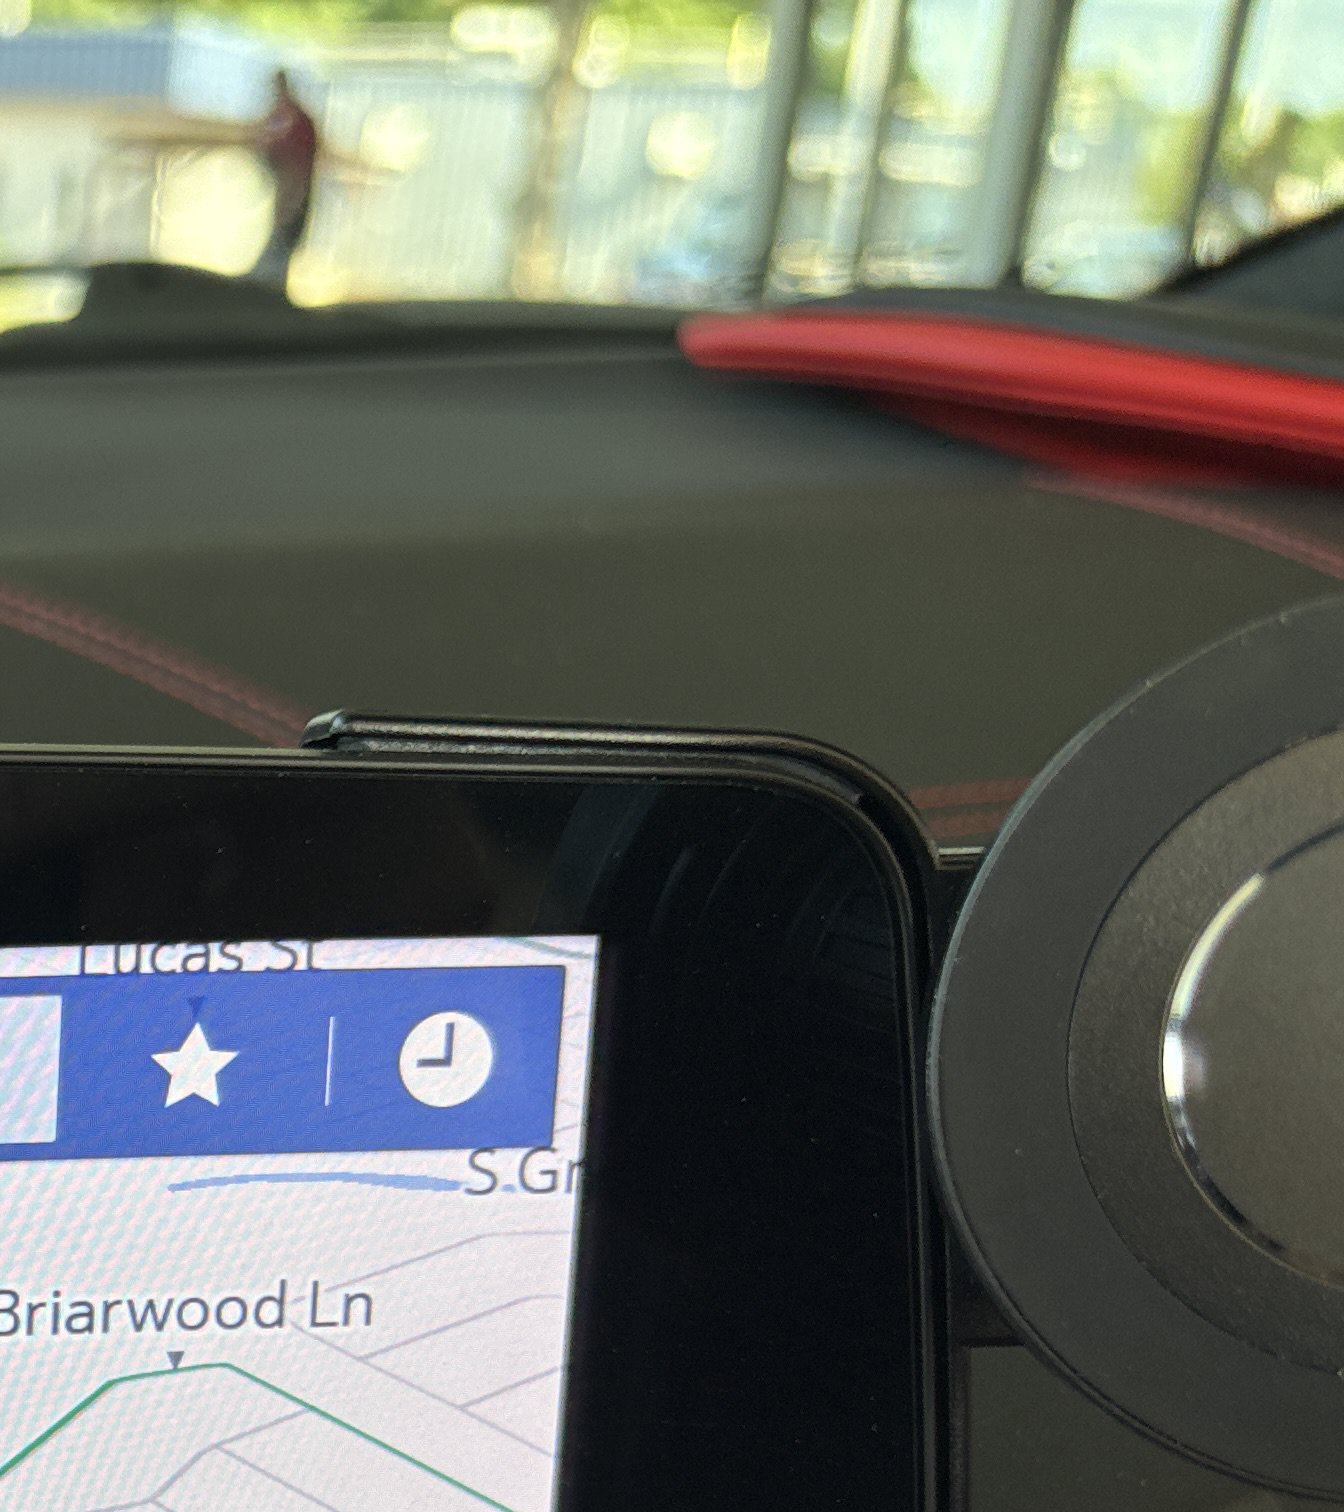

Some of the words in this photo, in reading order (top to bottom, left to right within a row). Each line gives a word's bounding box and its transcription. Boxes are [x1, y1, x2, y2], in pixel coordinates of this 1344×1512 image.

[79, 940, 244, 976] Lucas
[464, 1146, 498, 1196] S
[308, 1279, 374, 1329] Ln
